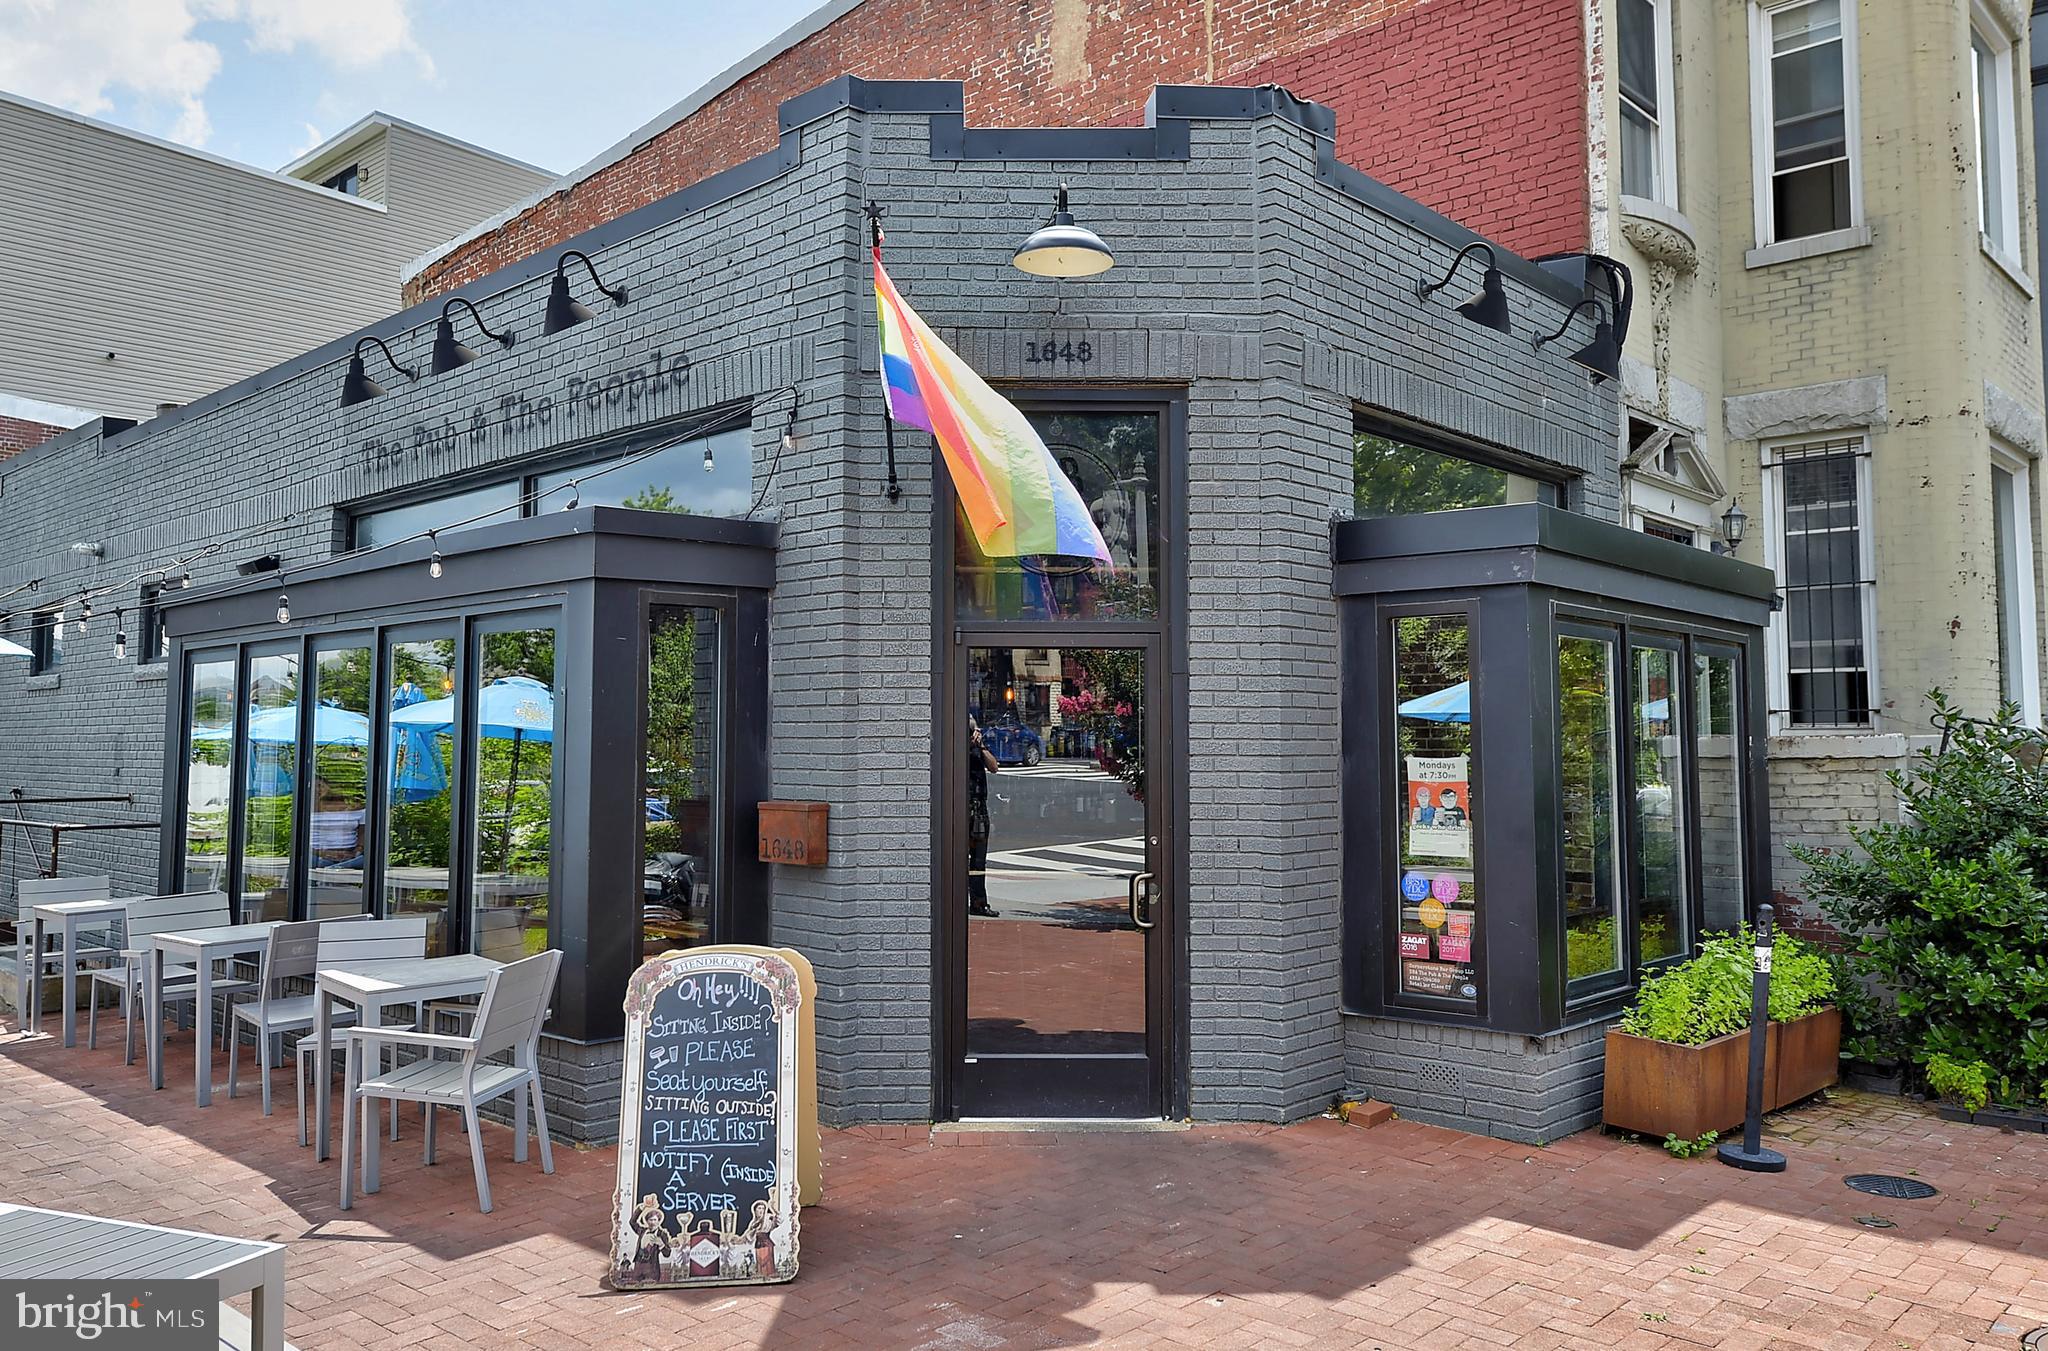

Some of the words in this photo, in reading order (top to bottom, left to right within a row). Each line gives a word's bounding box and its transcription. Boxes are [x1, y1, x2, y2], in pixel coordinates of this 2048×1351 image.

[362, 439, 403, 474] The
[414, 416, 456, 465] Pub
[471, 406, 487, 444] &
[502, 393, 551, 434] The
[567, 350, 690, 418] People
[1418, 762, 1456, 770] Mondays
[762, 838, 804, 860] 1648
[1402, 936, 1427, 944] ZAGAT
[680, 957, 750, 972] HENDRICK'S
[678, 978, 703, 1008] Oh
[685, 1038, 755, 1066] PLEASE
[646, 1070, 690, 1092] Seat
[645, 1095, 710, 1115] SITTING
[653, 1118, 720, 1145] PLEASE
[726, 1117, 769, 1141] FIRST
[642, 1152, 713, 1175] NOTIFY
[666, 1170, 686, 1186] A
